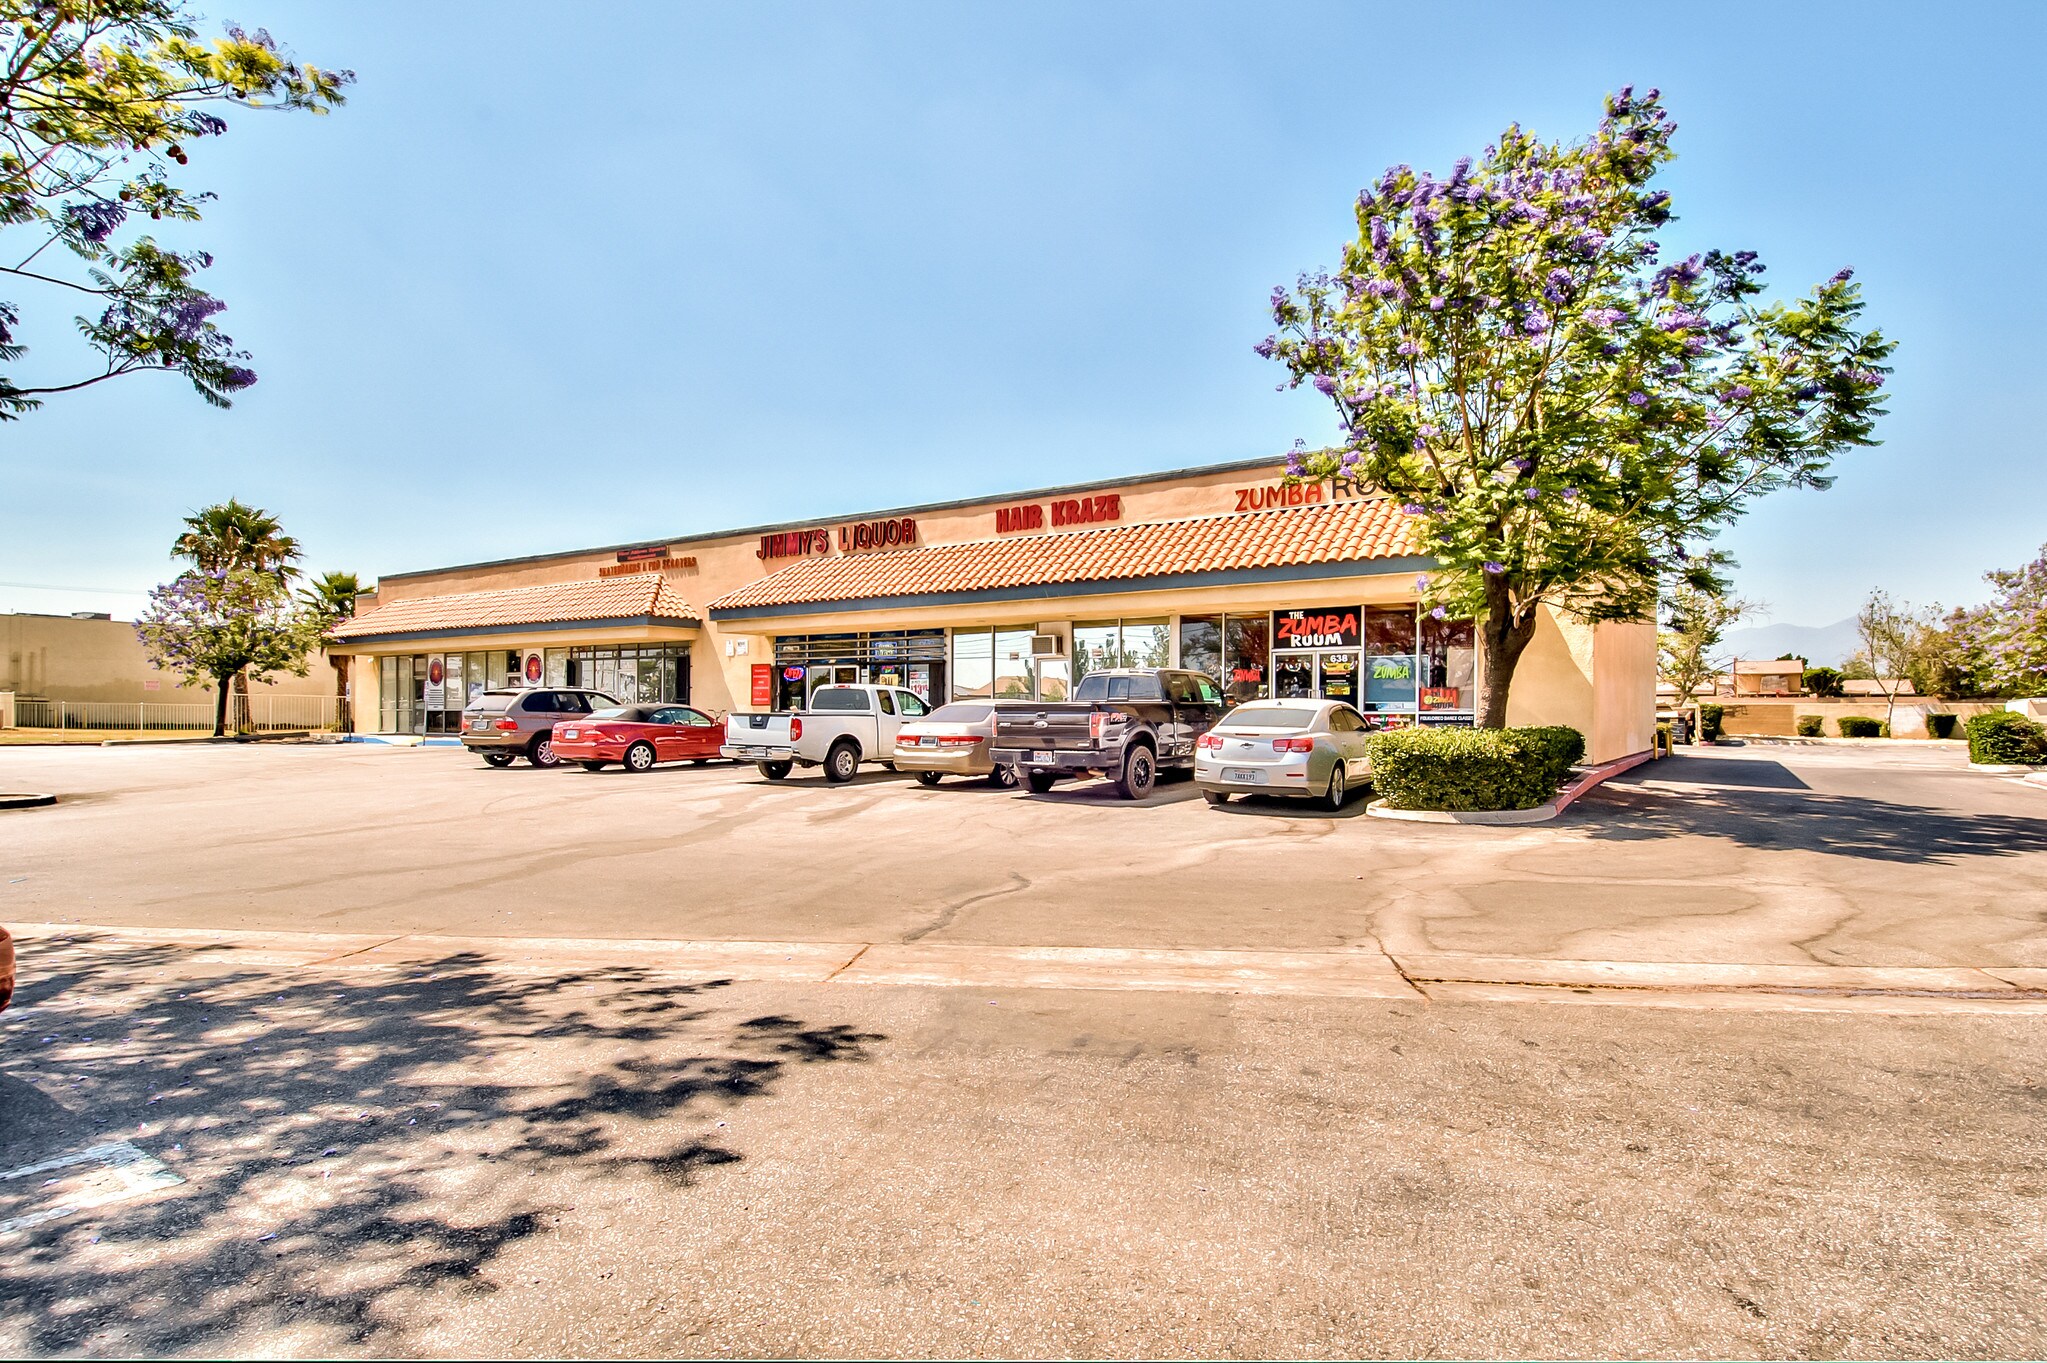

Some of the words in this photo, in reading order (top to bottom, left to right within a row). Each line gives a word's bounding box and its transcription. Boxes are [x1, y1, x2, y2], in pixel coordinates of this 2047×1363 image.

[1234, 482, 1322, 511] ZUMBA
[996, 505, 1043, 533] HAIR
[1051, 494, 1120, 527] KRAZE
[756, 528, 828, 559] JIMMY'S
[838, 518, 916, 550] LIQUOR
[1289, 611, 1304, 619] THE
[1278, 613, 1357, 639] ZUMBA
[1290, 633, 1343, 647] ROOM
[1330, 654, 1348, 662] 638
[1373, 665, 1410, 679] ZUMBA
